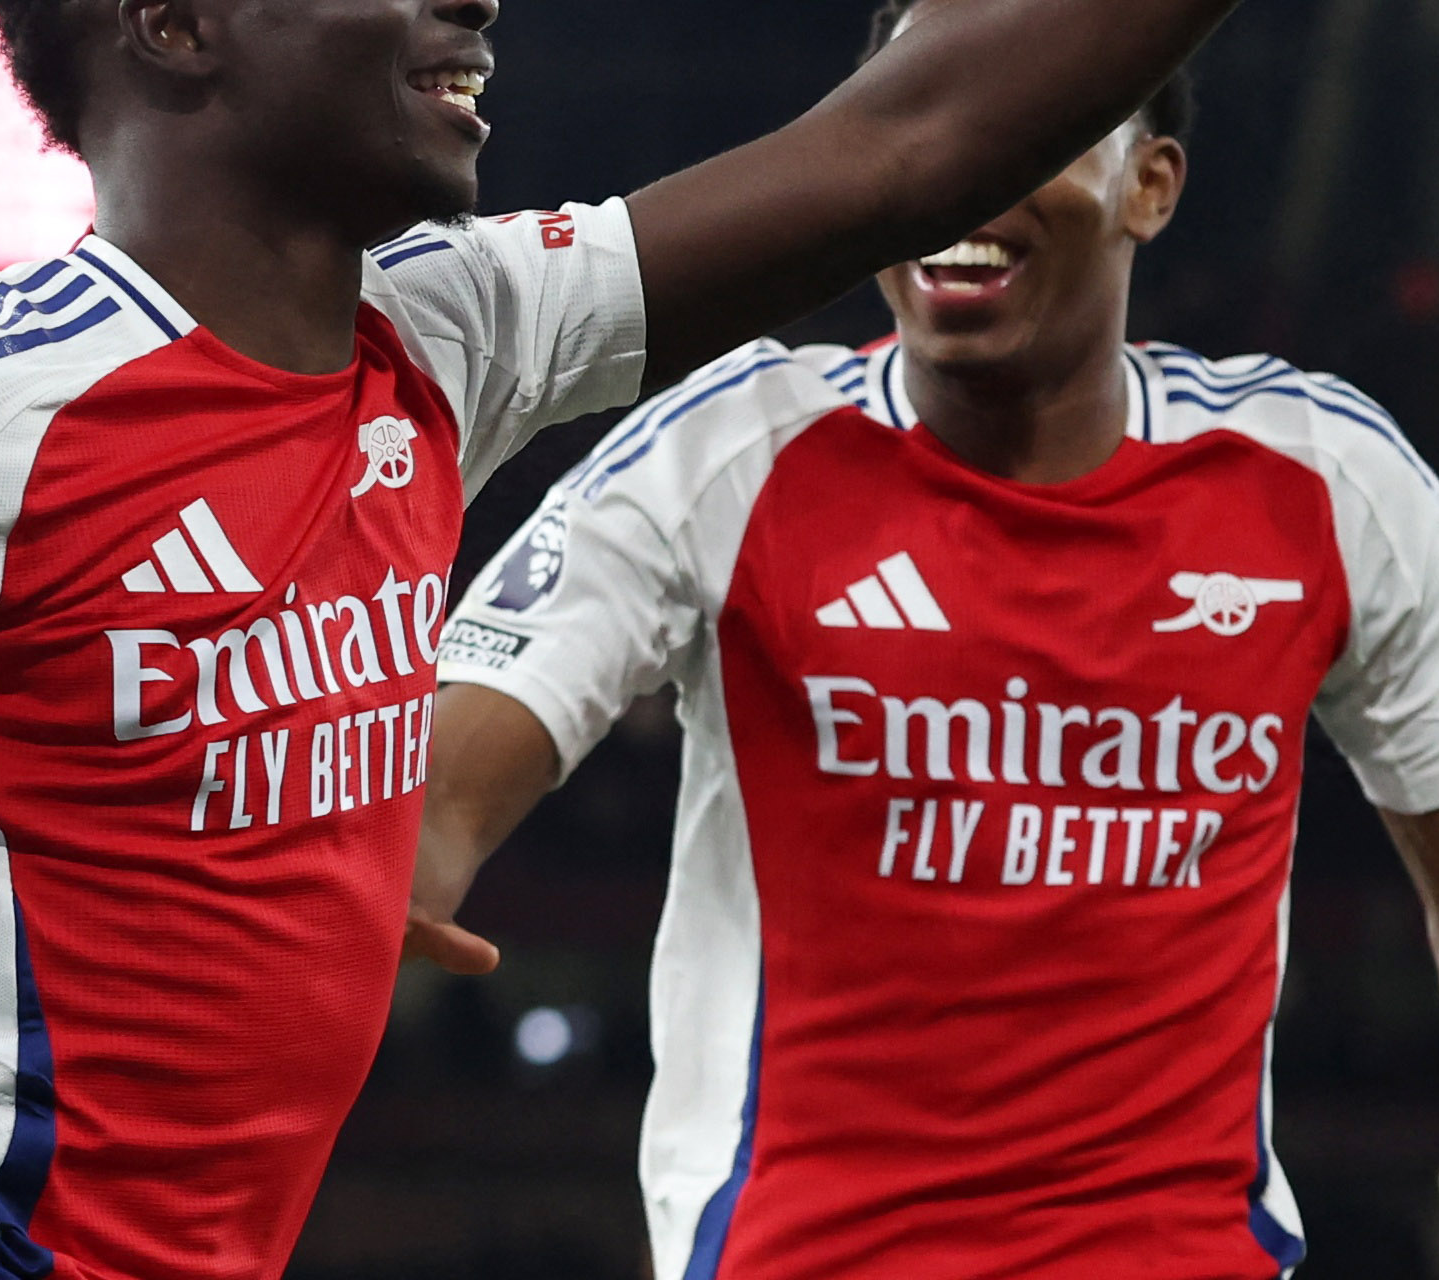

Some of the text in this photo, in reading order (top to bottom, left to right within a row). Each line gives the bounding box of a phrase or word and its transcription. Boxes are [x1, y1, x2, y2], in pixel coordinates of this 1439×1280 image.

[103, 563, 453, 741] Emirate
[190, 692, 433, 832] FLY BETTER
[801, 675, 1283, 794] Emirates
[877, 798, 1224, 888] FLY BETTER
